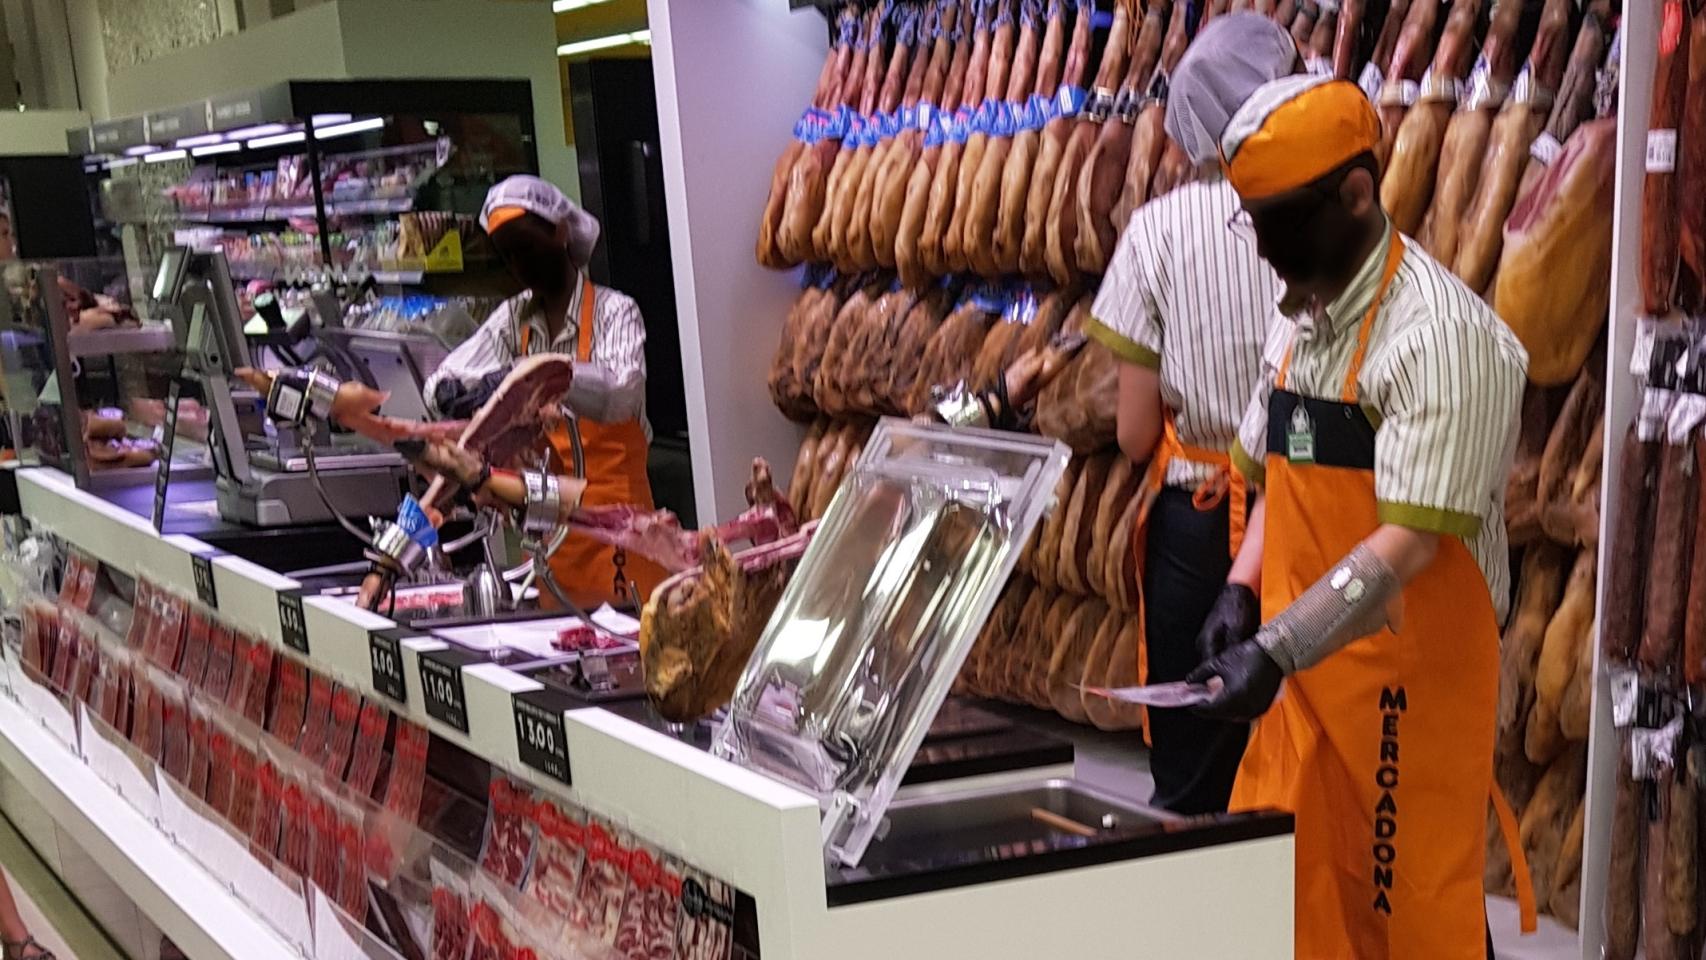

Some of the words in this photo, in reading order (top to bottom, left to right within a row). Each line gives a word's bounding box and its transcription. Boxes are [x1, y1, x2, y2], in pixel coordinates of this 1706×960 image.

[422, 669, 454, 707] 11,00
[518, 711, 555, 755] 13,00
[1372, 686, 1408, 916] MERCADONA
